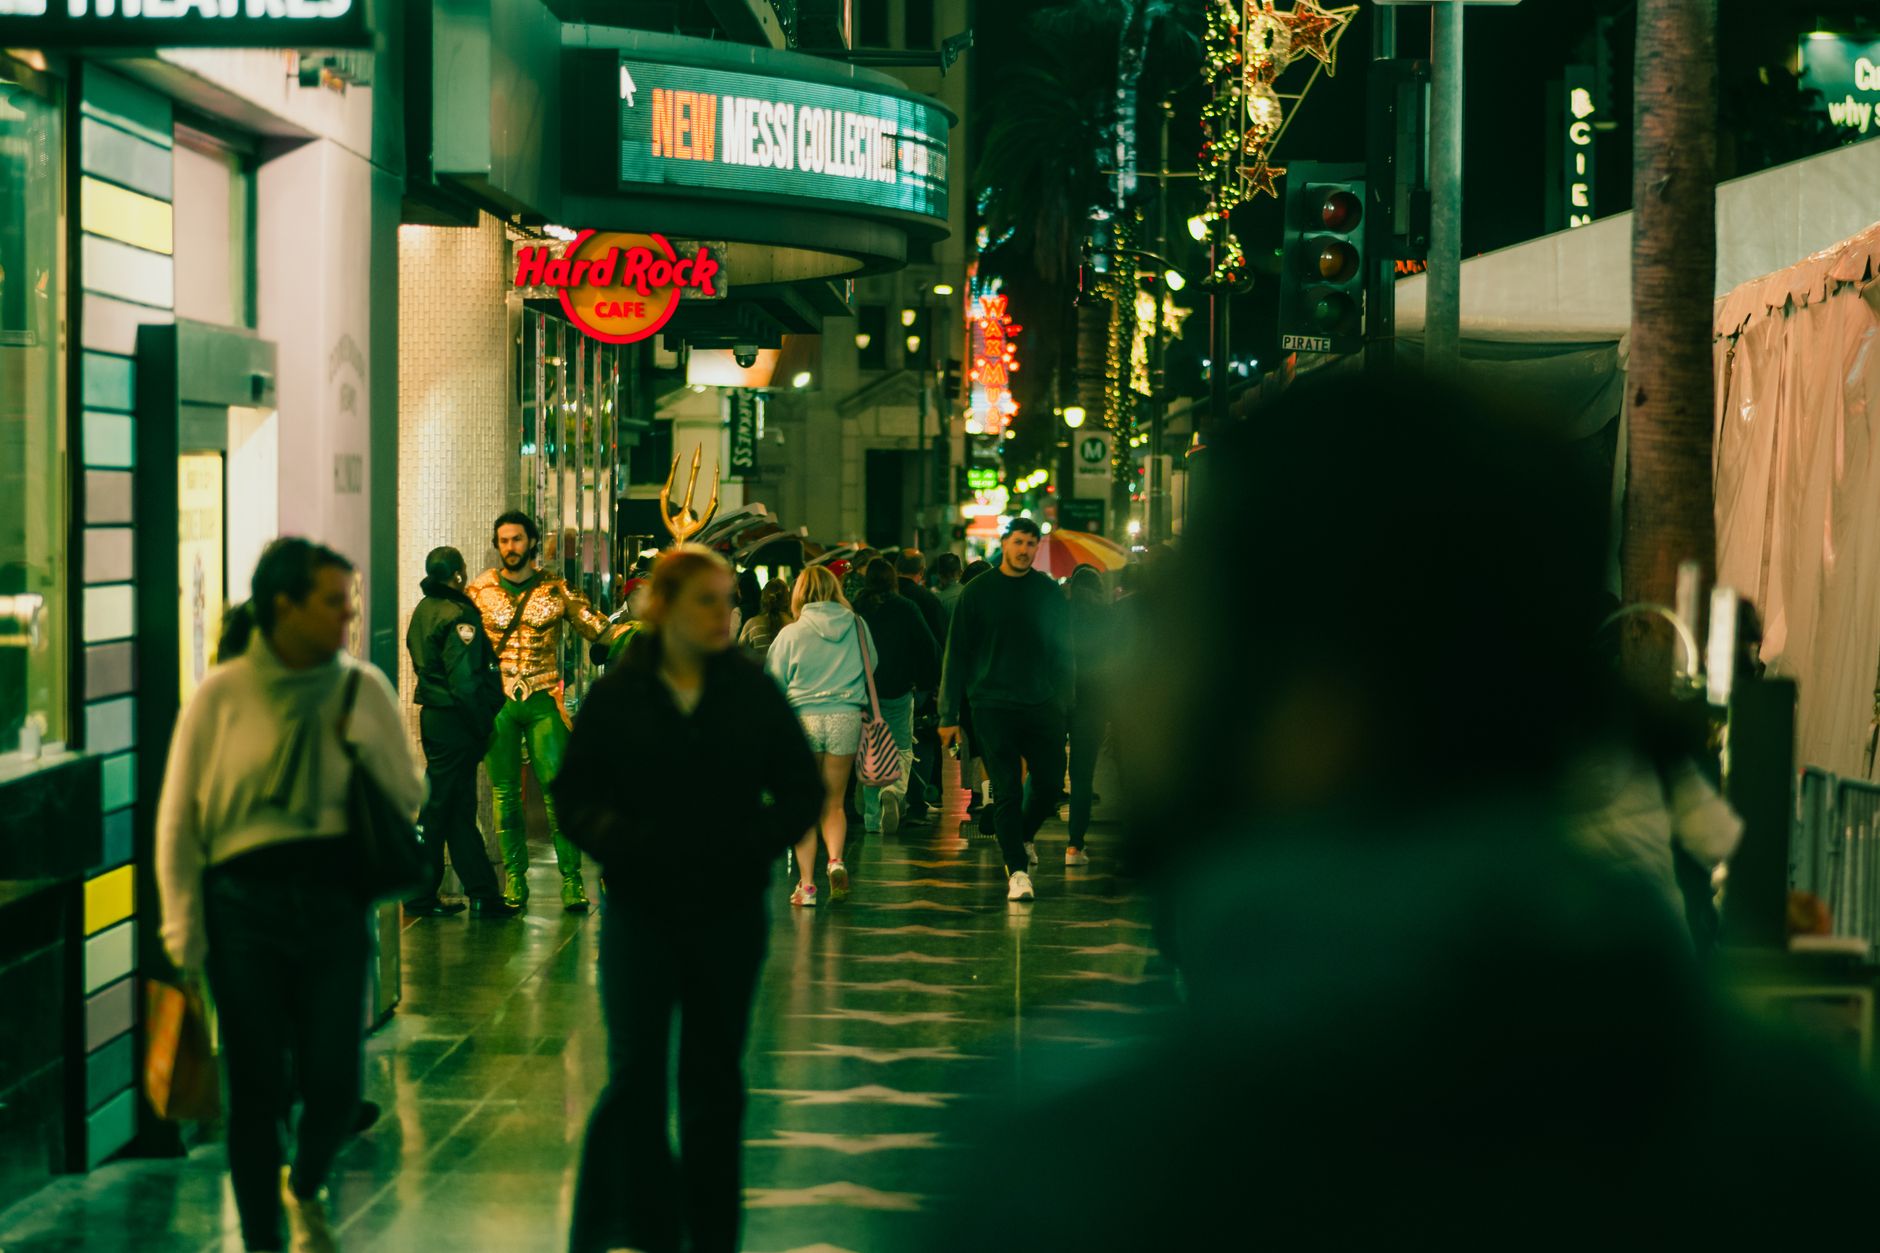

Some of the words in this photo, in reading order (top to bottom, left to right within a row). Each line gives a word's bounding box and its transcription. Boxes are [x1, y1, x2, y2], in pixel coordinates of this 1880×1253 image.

[1828, 94, 1872, 133] why
[652, 88, 717, 162] NEW
[722, 95, 795, 170] MESSI
[797, 106, 897, 184] COLLECTION
[515, 246, 619, 288] Hard
[622, 246, 719, 297] Rock
[595, 301, 646, 319] CAFE
[1283, 336, 1330, 350] PIRATE
